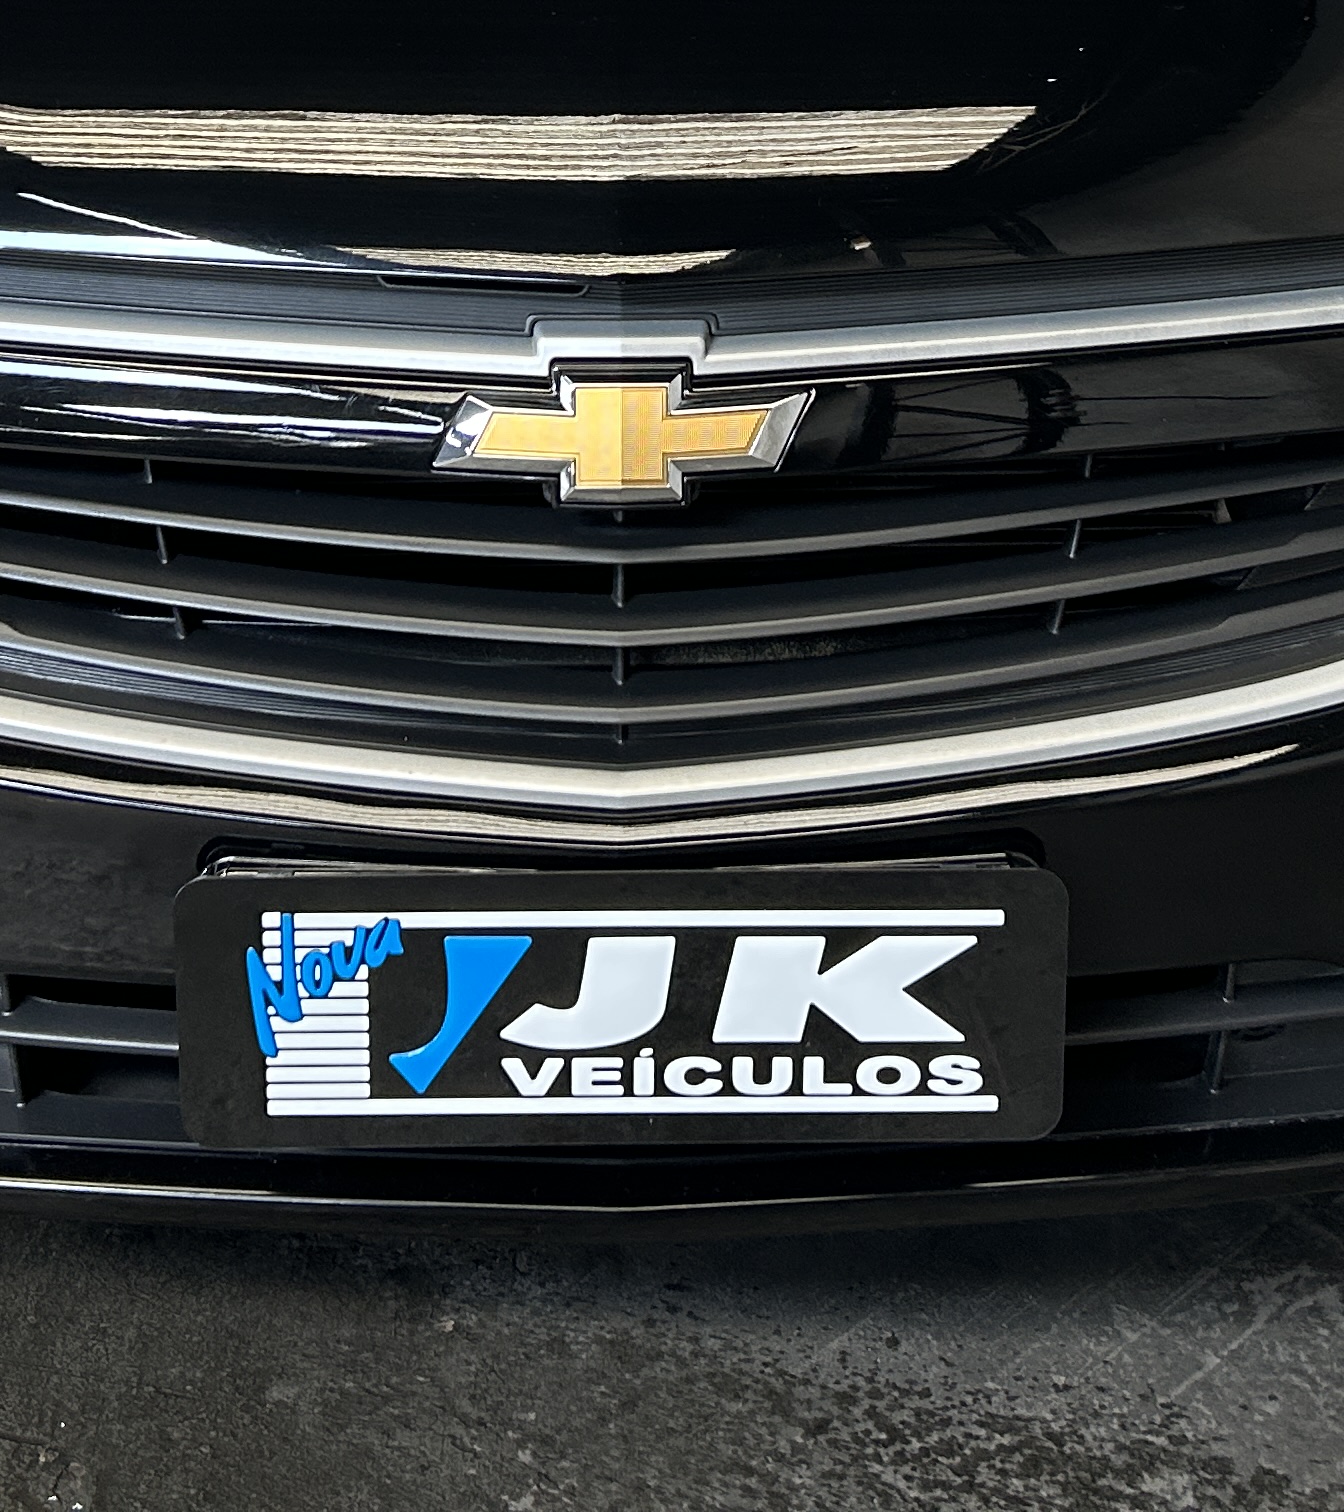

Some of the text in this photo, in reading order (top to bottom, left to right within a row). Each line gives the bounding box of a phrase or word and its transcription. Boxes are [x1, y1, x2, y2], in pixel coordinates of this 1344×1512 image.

[246, 912, 979, 1058] Nova JK
[500, 1048, 984, 1098] VEÍCULOS
